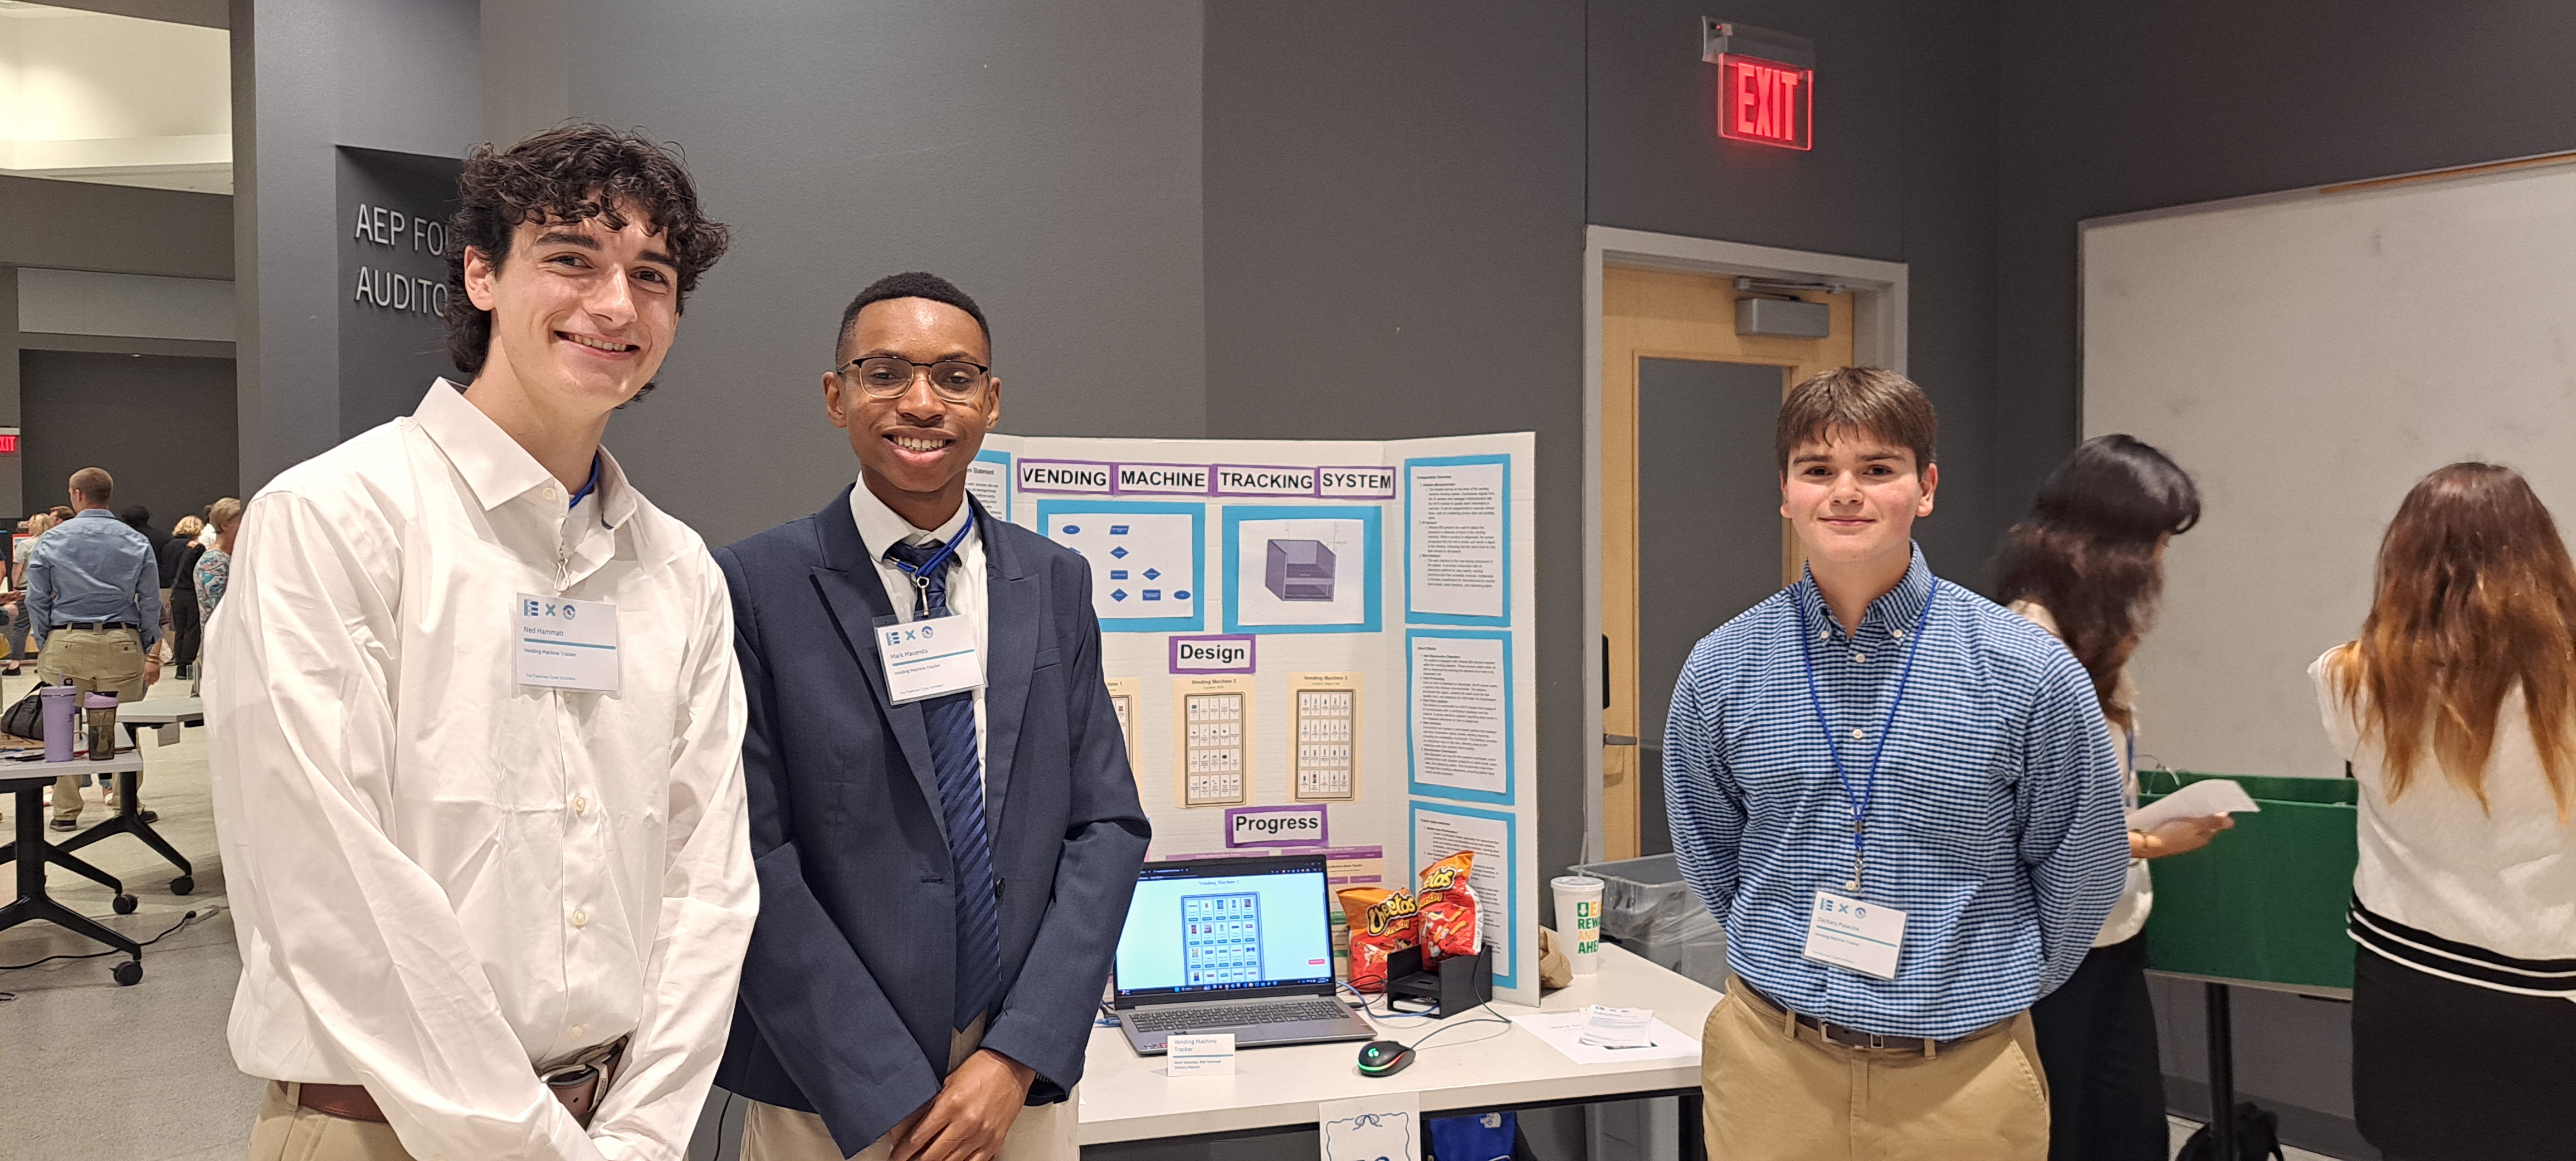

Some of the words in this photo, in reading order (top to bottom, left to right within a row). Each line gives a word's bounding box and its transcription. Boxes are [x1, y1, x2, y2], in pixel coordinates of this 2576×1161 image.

[1738, 62, 1798, 140] EXIT
[355, 203, 405, 246] AEP
[355, 266, 447, 317] AUDITO
[1023, 467, 1106, 486] VENDING
[1121, 471, 1206, 487] MACHINE
[1219, 472, 1313, 489] TRACKING
[1323, 474, 1391, 489] SYSTEM
[537, 628, 564, 636] Hammatt
[890, 651, 904, 659] Mark
[904, 648, 928, 657] Masenda
[1180, 644, 1245, 664] Design
[1236, 816, 1319, 834] Progress
[1369, 894, 1416, 934] Cheetos
